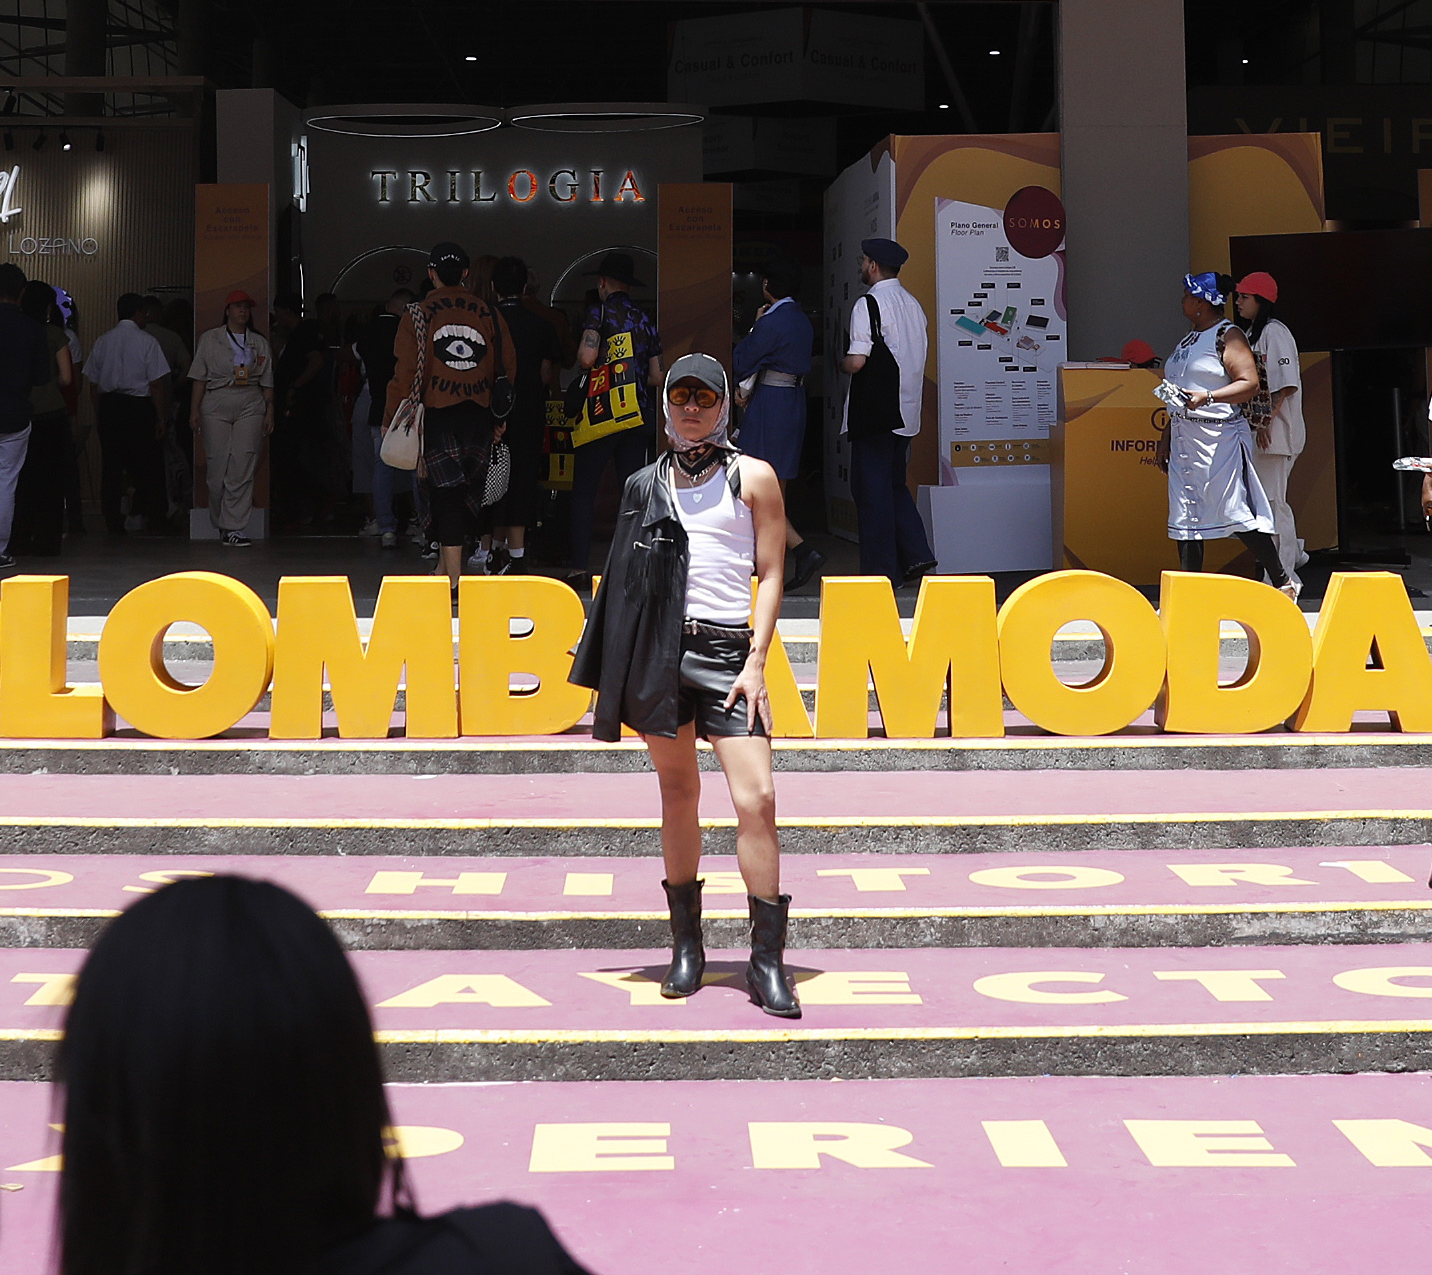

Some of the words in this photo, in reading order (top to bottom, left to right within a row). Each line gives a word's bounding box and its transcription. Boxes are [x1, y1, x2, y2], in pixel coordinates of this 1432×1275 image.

[369, 169, 647, 203] TRILOGIA
[678, 205, 713, 213] Acceso
[950, 221, 971, 229] Plano
[972, 221, 999, 229] General
[1009, 217, 1061, 229] SOMOS
[8, 233, 99, 254] LOZANO
[1111, 440, 1157, 452] INFOR
